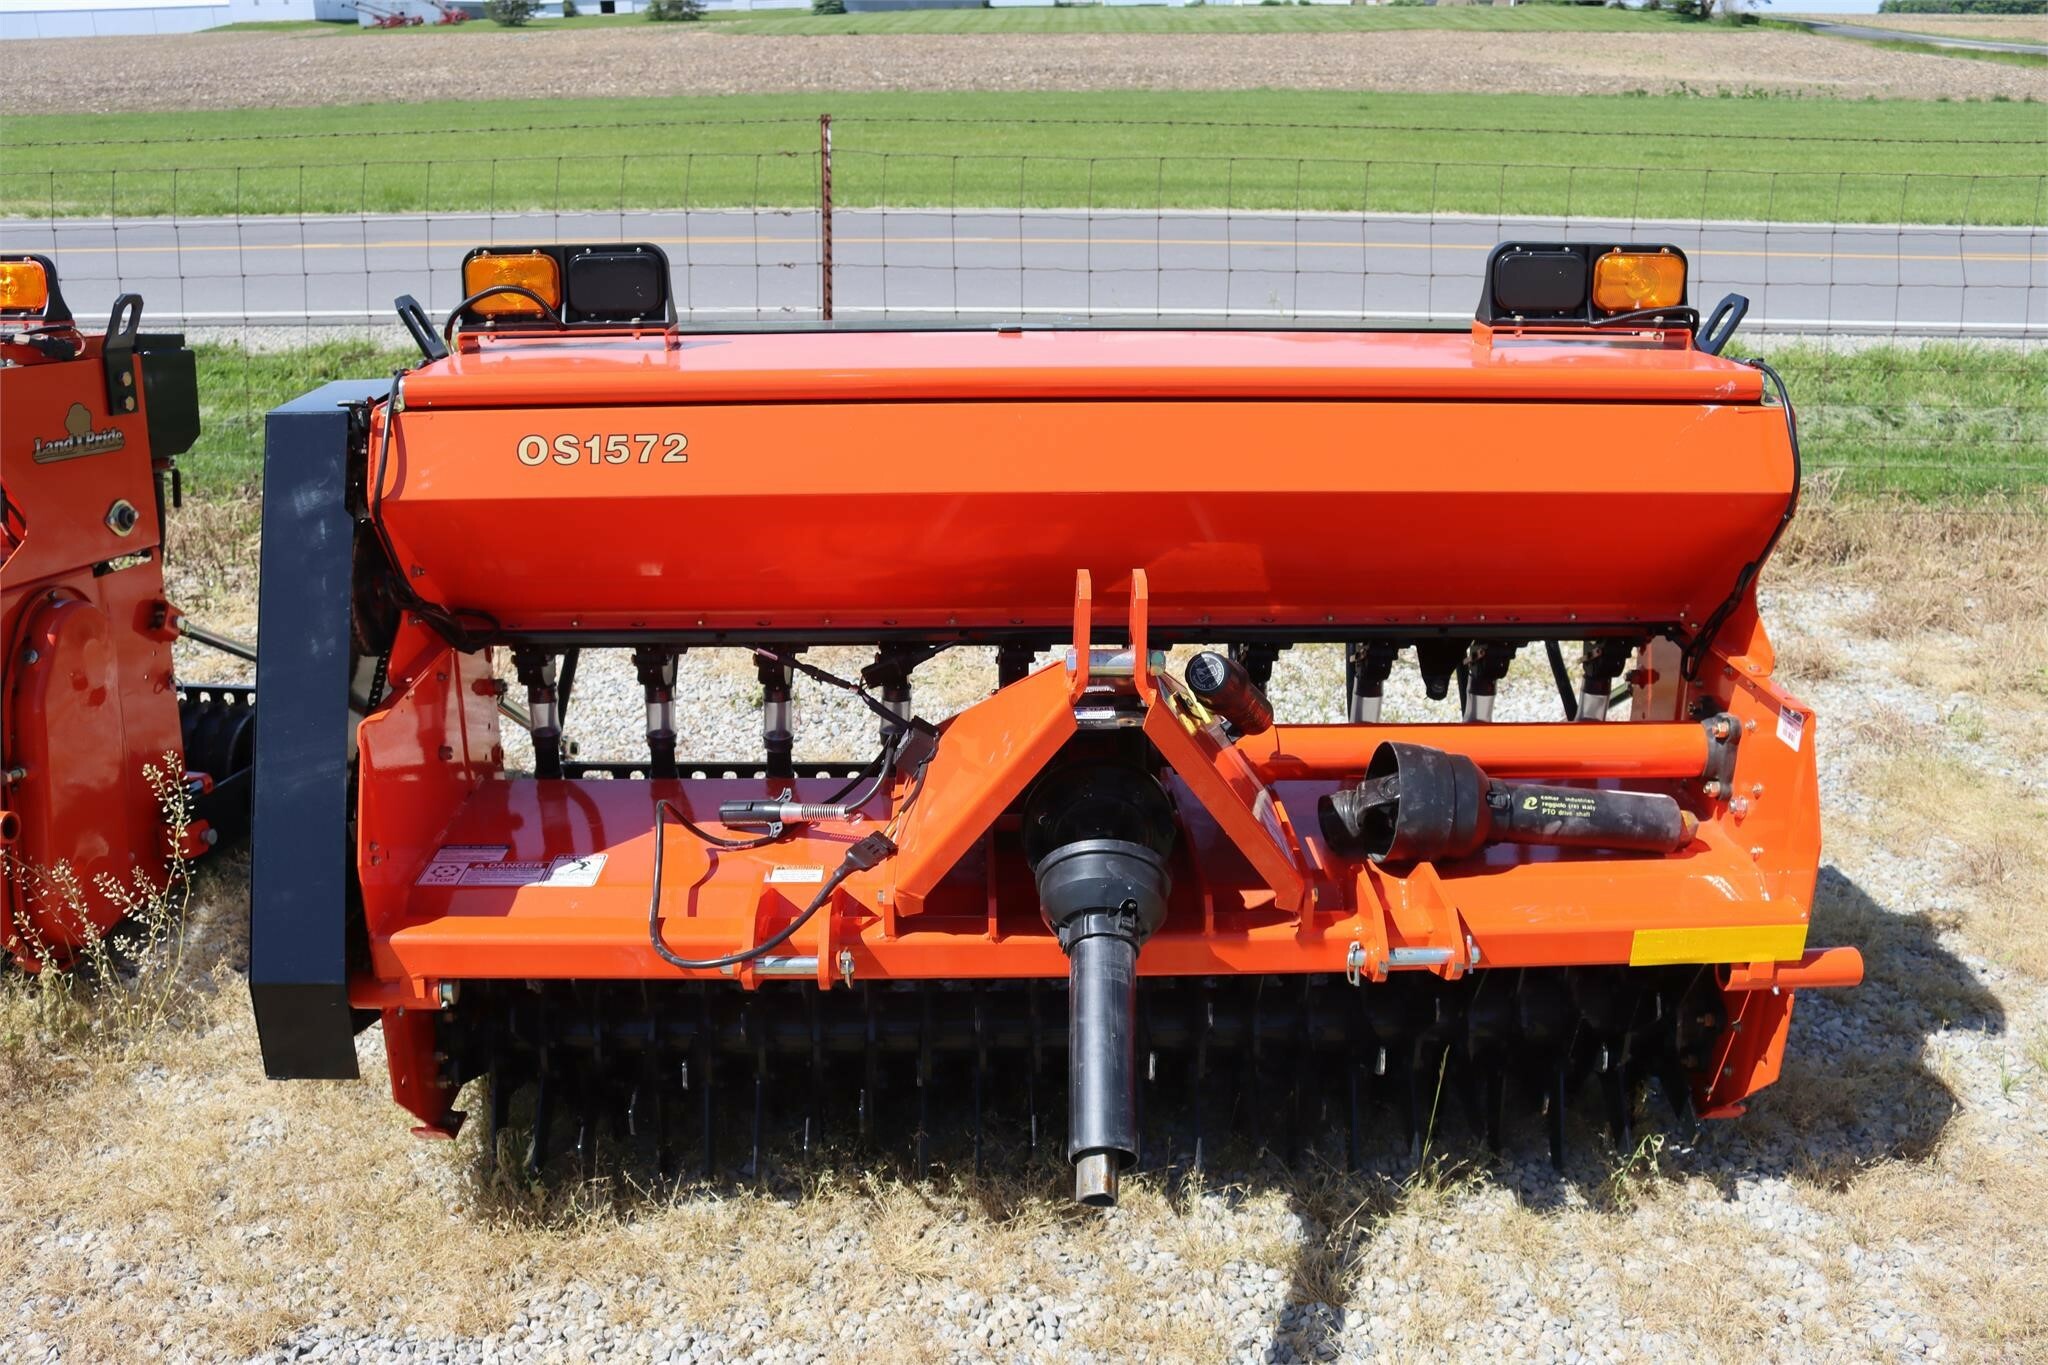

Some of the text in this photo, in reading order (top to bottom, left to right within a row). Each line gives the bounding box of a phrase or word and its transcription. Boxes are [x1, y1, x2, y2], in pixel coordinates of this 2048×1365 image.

[34, 429, 123, 456] Land Pride
[516, 433, 688, 466] OS1572
[1558, 809, 1573, 817] drive
